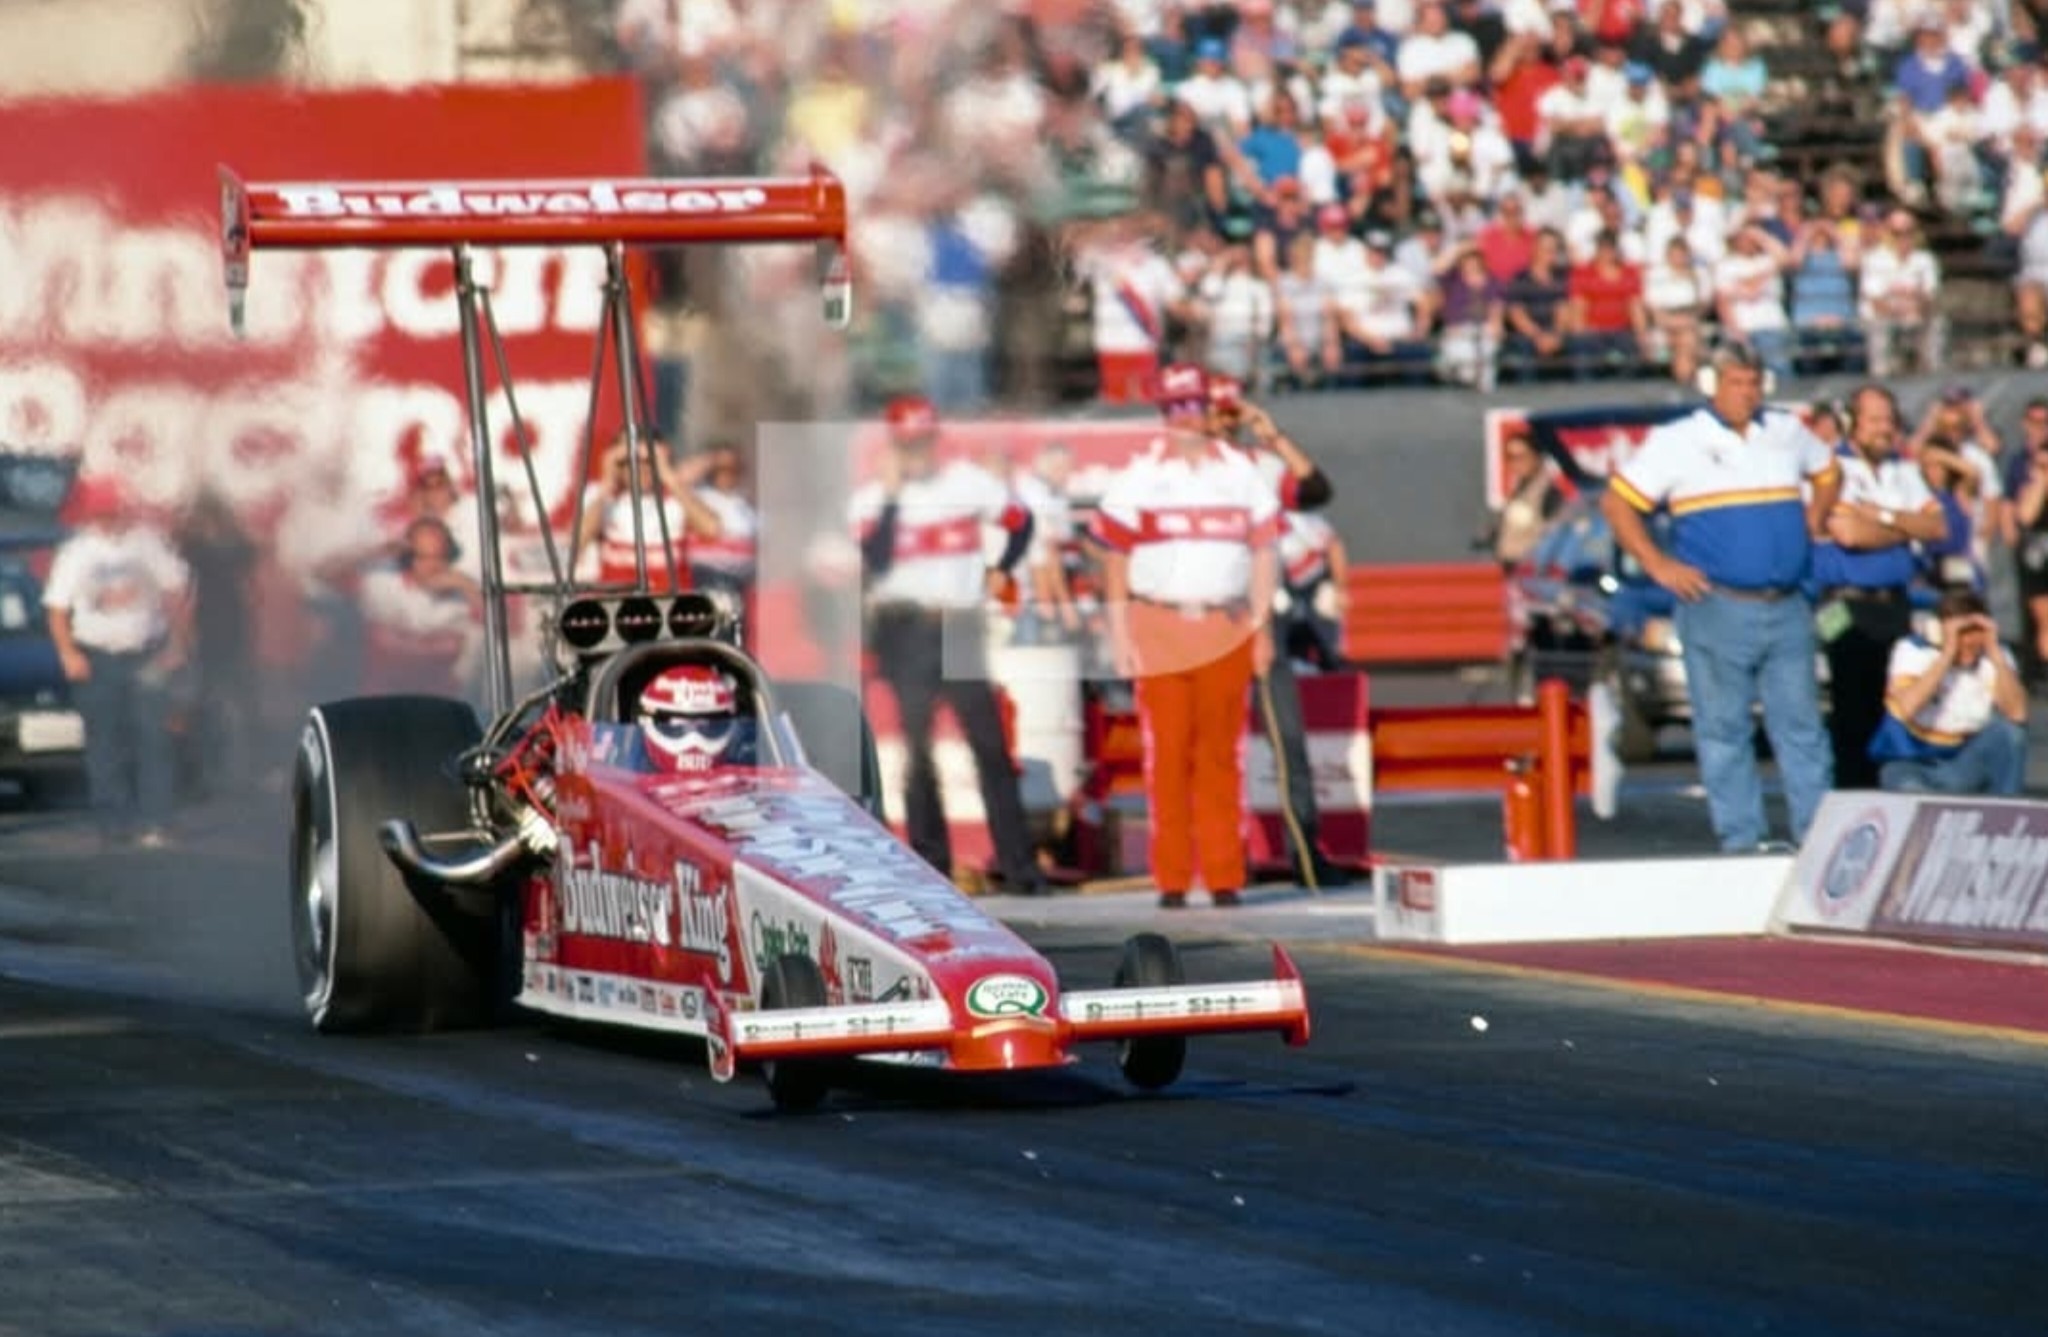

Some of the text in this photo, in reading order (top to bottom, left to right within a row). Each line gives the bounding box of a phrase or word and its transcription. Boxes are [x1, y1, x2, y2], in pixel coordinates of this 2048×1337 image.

[277, 183, 767, 218] Budweiser
[559, 833, 674, 947] Budweiser
[674, 858, 732, 984] King
